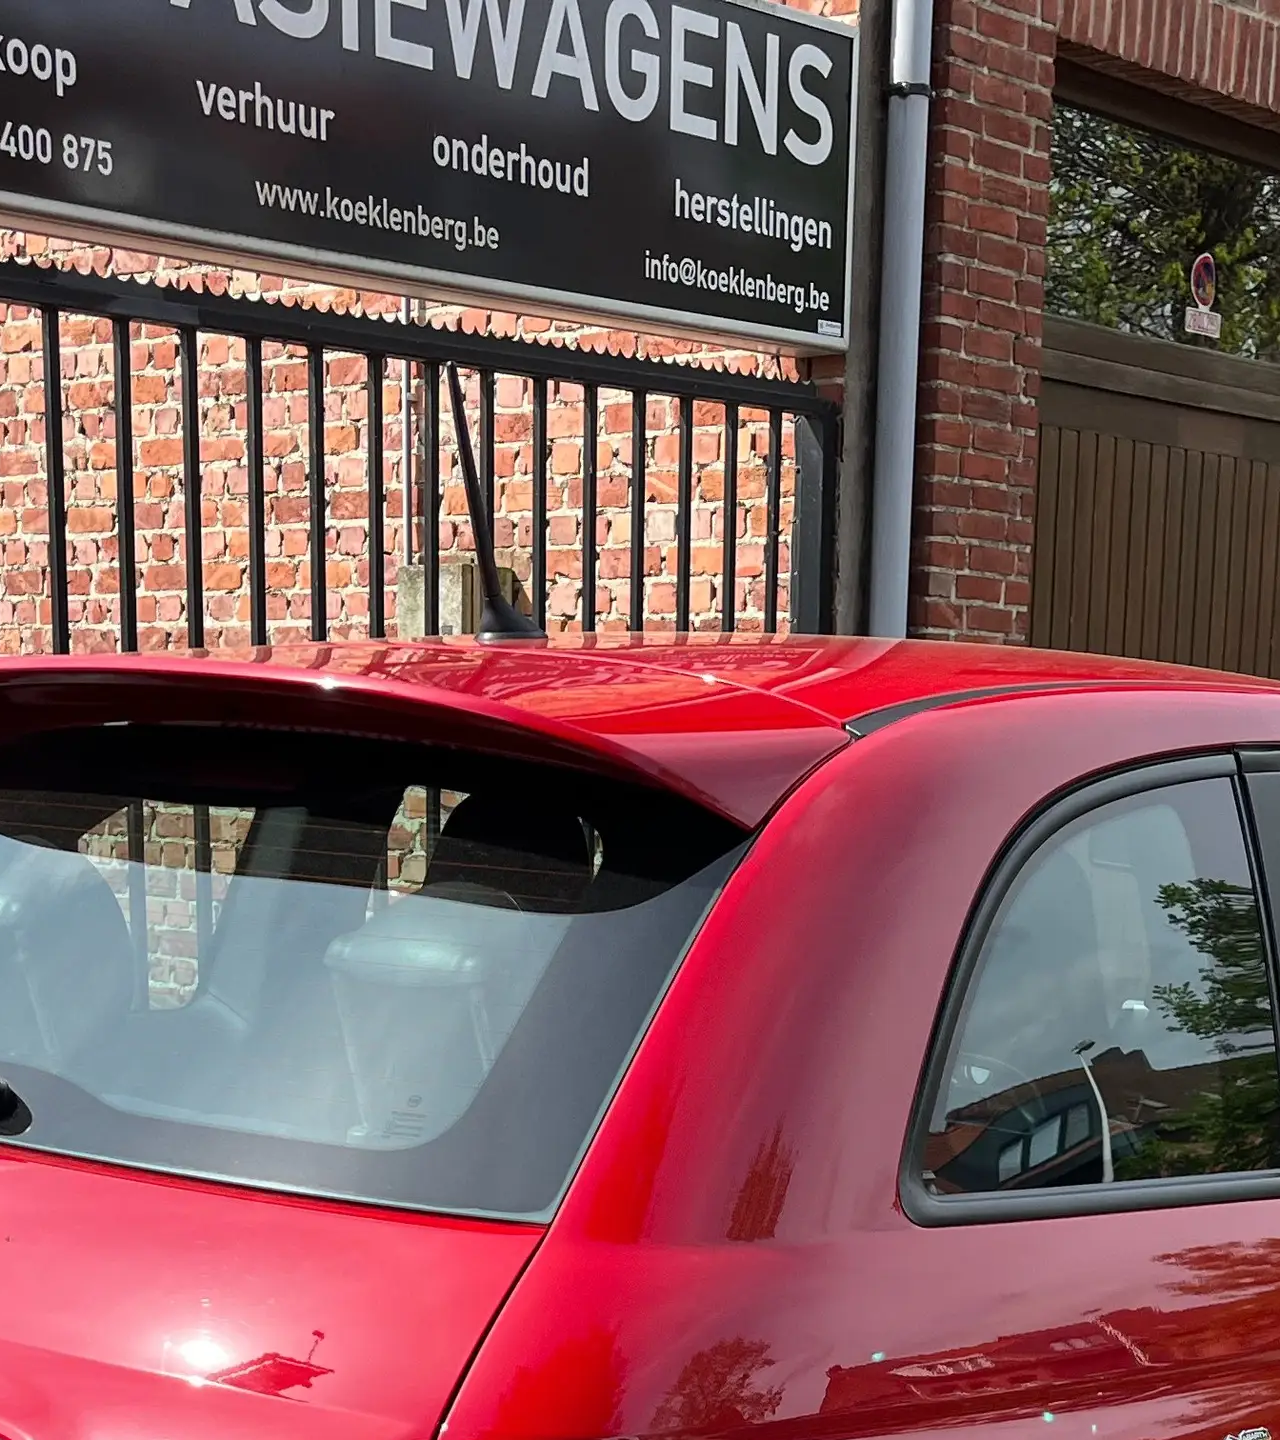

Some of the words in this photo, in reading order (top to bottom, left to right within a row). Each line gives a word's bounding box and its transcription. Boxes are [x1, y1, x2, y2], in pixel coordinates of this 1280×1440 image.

[196, 80, 335, 141] verhuur
[0, 121, 53, 164] 400
[62, 133, 113, 176] 875
[432, 131, 590, 198] onderhoud
[255, 180, 500, 251] www.koeklenberg.be
[674, 178, 832, 252] herstellingen
[645, 250, 830, 314] info@koeklenberg.be
